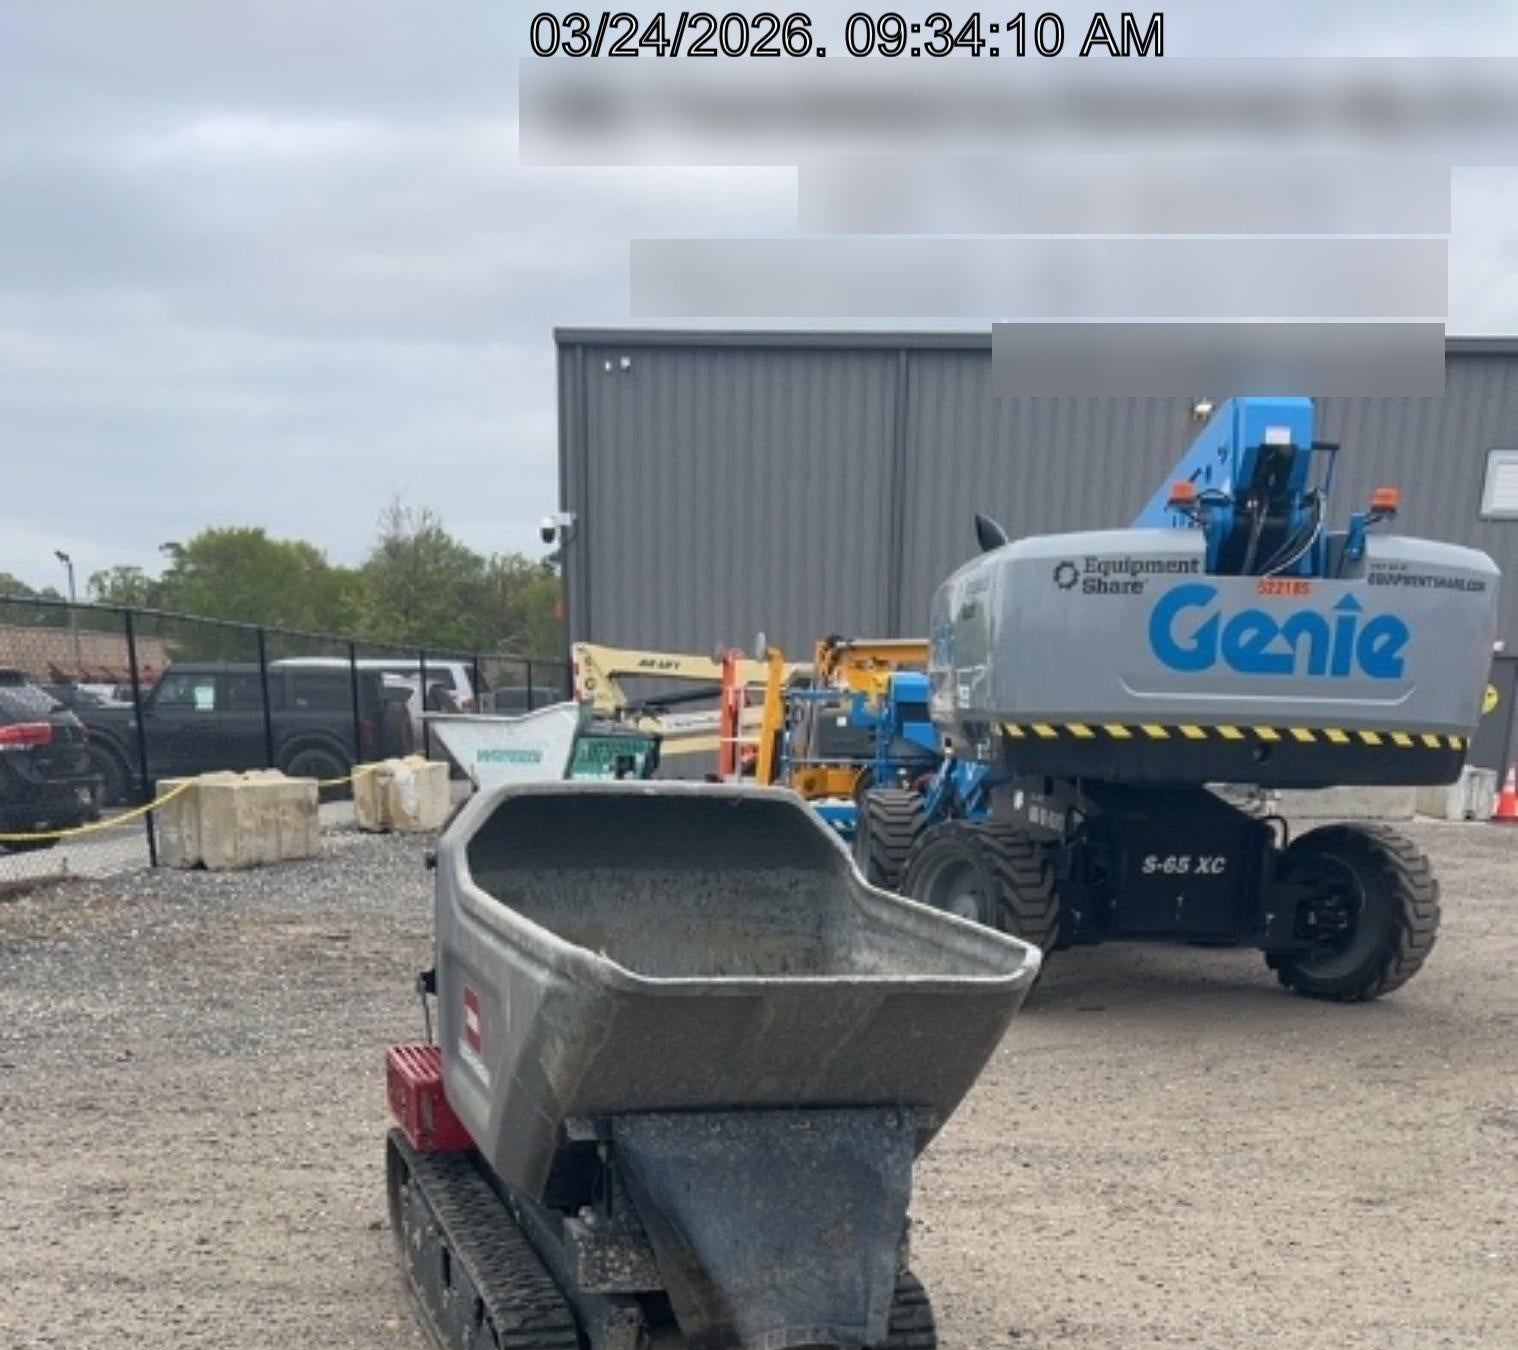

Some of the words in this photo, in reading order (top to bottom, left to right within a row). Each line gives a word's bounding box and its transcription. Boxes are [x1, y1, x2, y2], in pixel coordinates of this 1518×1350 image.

[1085, 556, 1200, 577] Equipment
[1083, 577, 1144, 595] Share
[1149, 583, 1410, 679] Genie
[1142, 854, 1191, 874] S-65
[1193, 855, 1226, 874] XC
